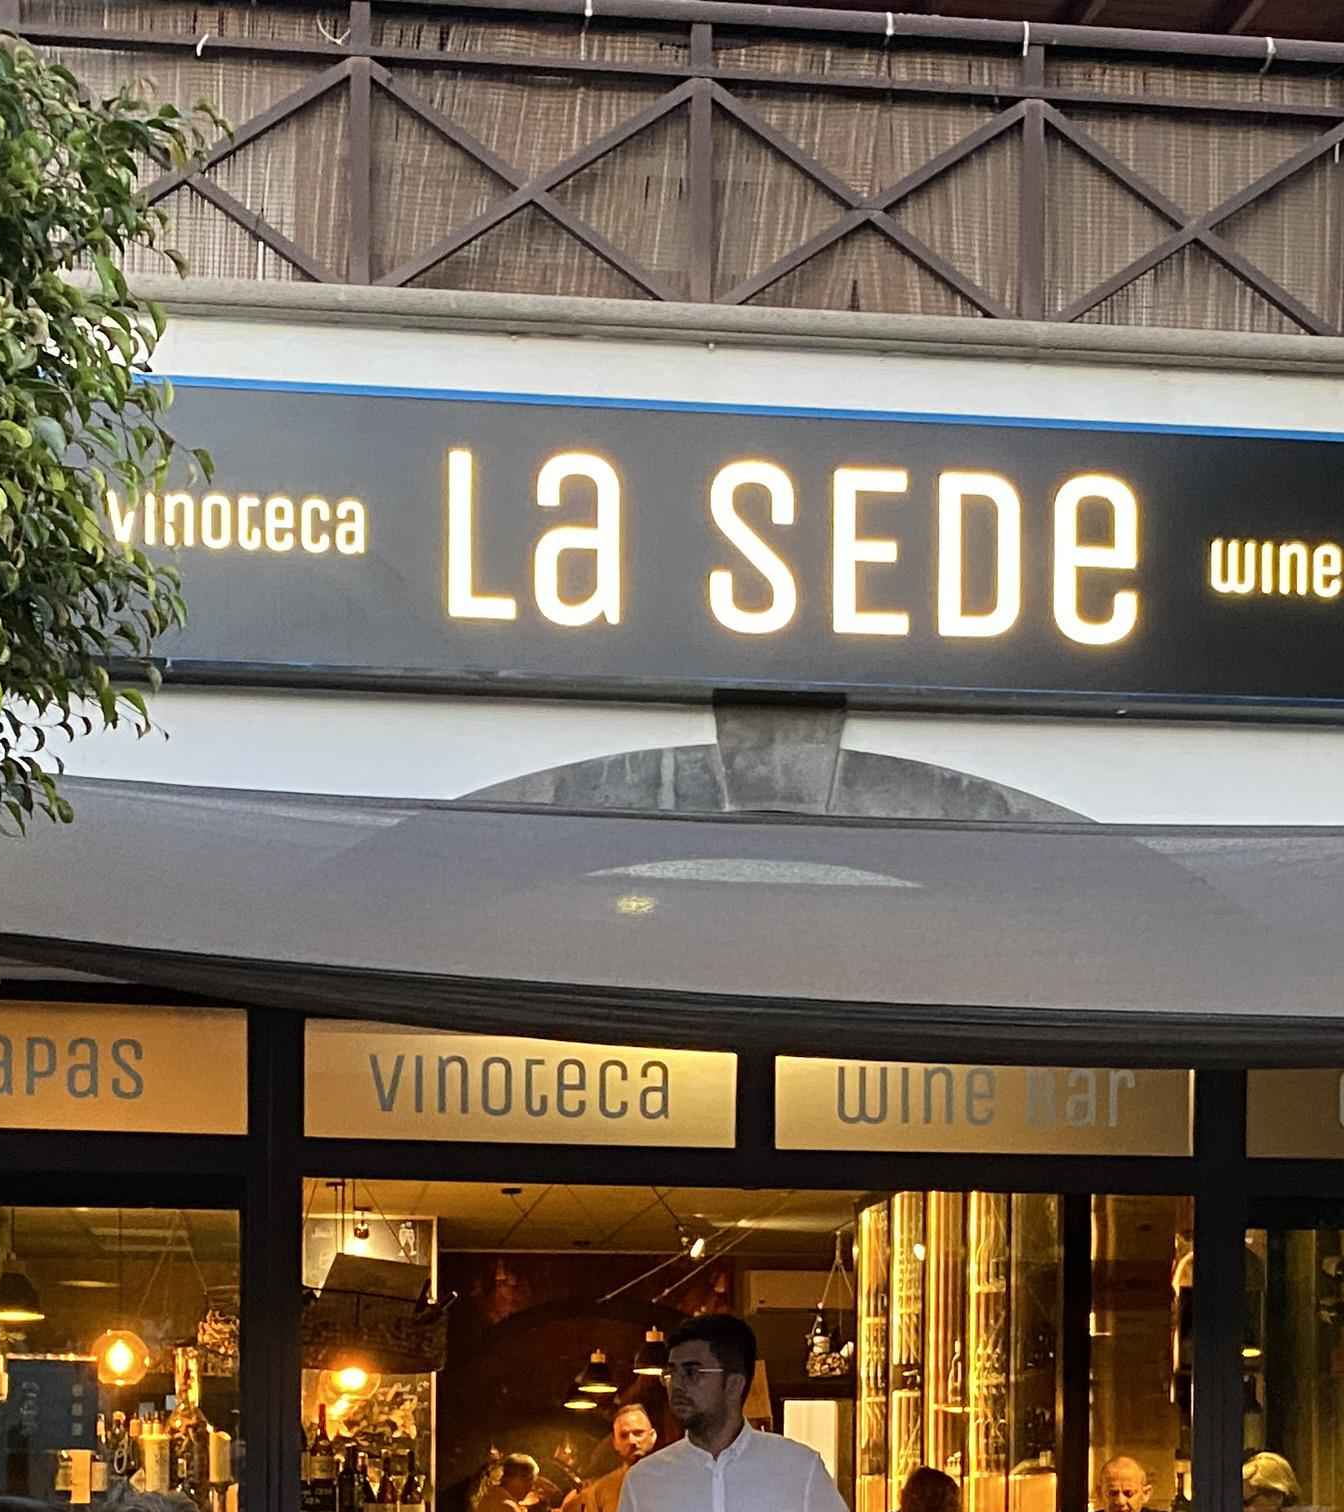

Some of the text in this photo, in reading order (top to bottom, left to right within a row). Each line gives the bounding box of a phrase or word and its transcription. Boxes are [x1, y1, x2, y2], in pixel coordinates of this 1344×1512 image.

[106, 491, 366, 555] vinoteca
[1210, 539, 1343, 598] wine
[369, 1054, 669, 1119] vinoteca
[837, 1065, 996, 1126] wine
